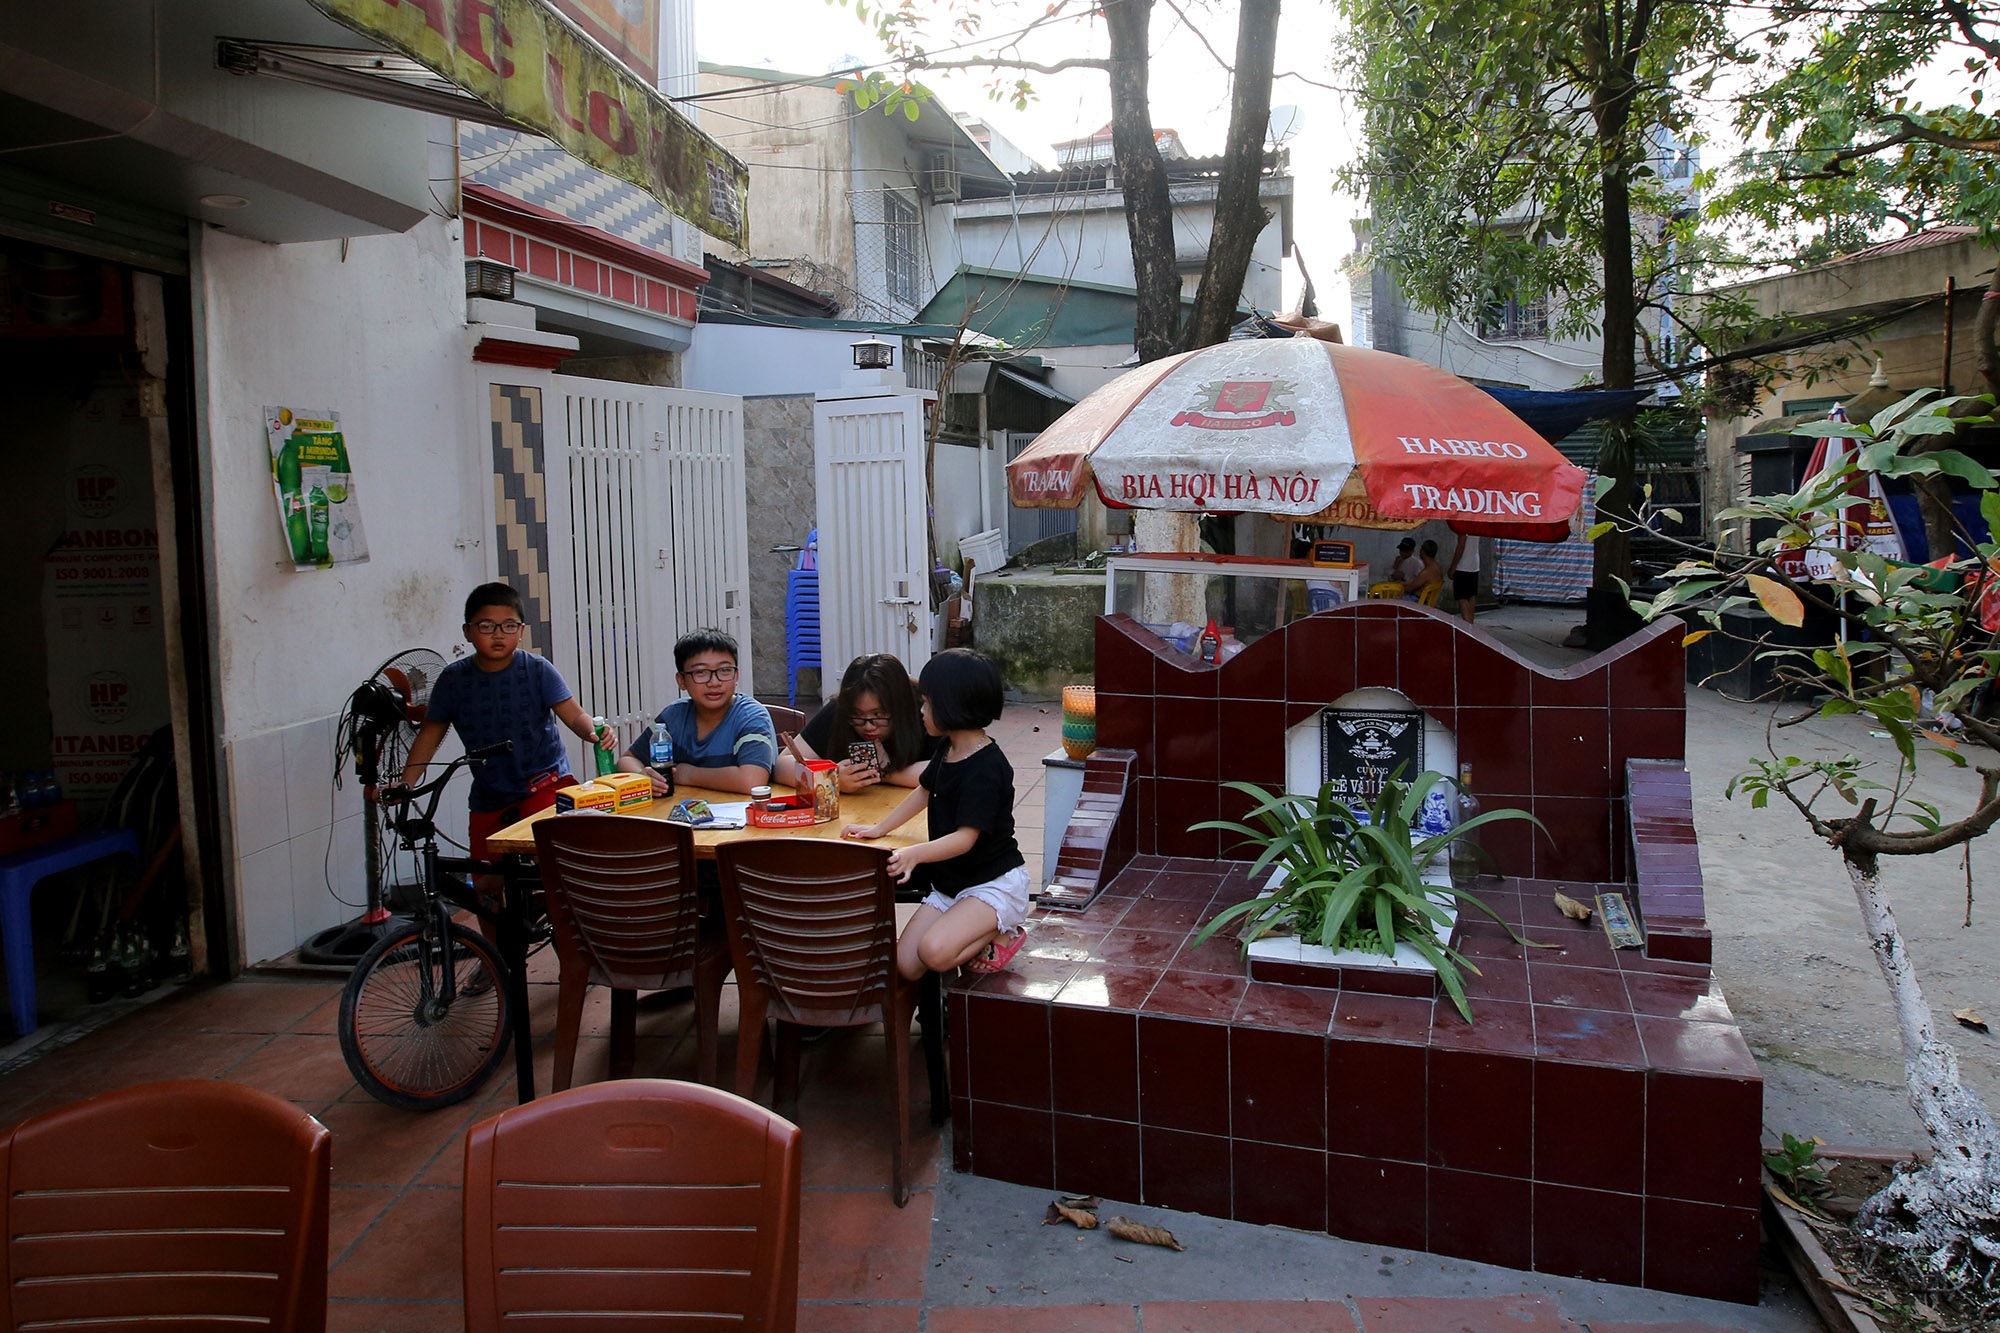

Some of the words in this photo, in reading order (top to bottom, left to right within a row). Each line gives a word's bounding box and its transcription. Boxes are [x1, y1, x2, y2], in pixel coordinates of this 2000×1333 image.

[1200, 418, 1263, 427] HABECO
[1396, 436, 1528, 459] HABECO
[77, 477, 115, 497] HP
[1023, 470, 1073, 493] TRADIN
[1121, 474, 1165, 499] BIA
[1223, 469, 1262, 499] HÀ
[1267, 470, 1320, 506] NỘI
[1403, 484, 1542, 517] TRADING
[84, 553, 144, 562] COMPOSITE
[56, 568, 78, 580] ISO
[83, 567, 150, 579] 9001:2008
[89, 683, 128, 702] HP
[52, 760, 93, 768] UMINUM
[69, 772, 92, 784] ISO
[1331, 774, 1348, 793] LÊ
